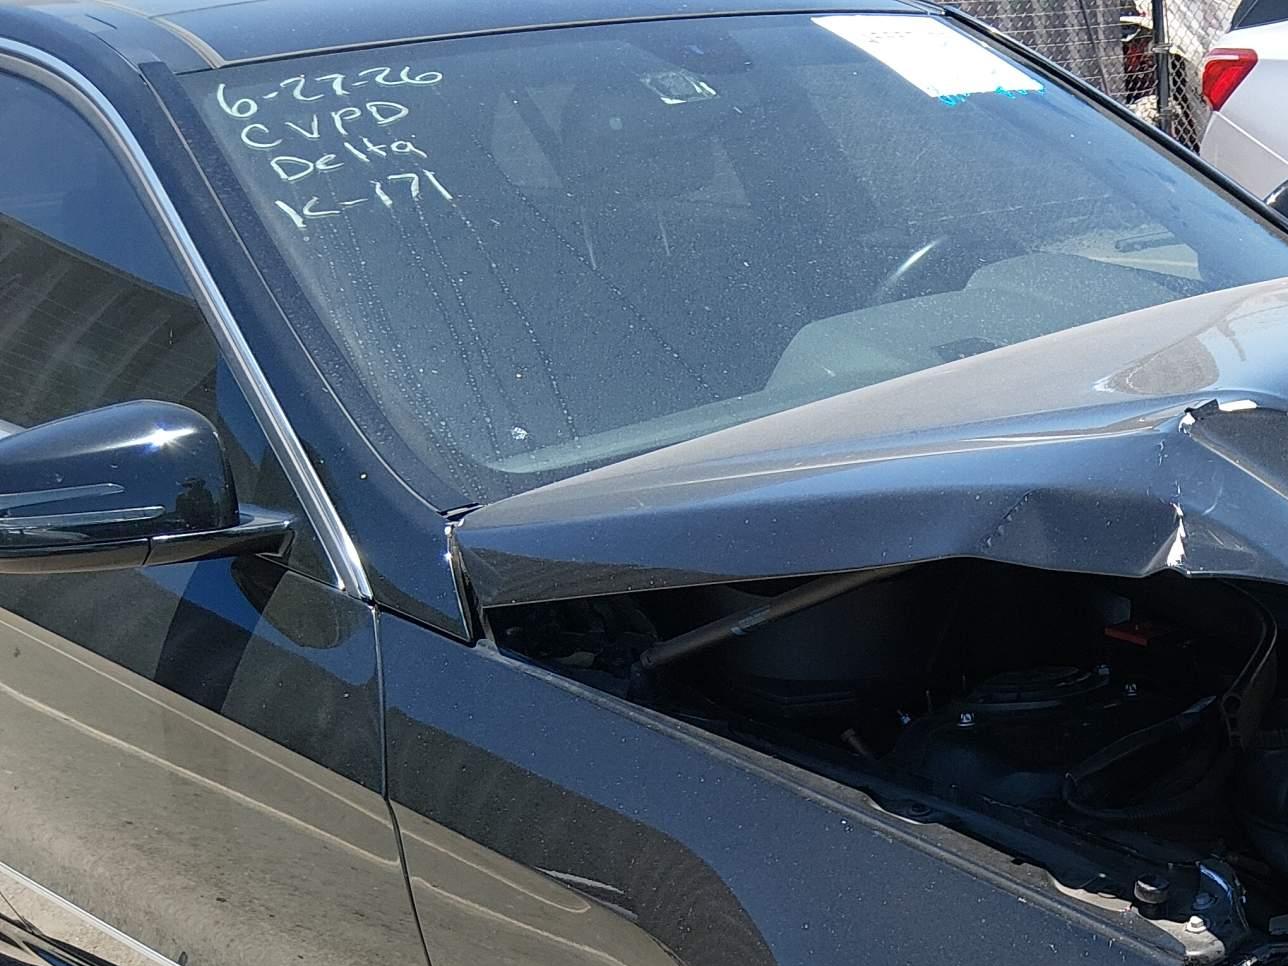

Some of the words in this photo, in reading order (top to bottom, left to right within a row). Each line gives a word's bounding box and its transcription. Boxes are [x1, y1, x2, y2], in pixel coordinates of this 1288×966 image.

[216, 66, 443, 118] 6-27-26
[270, 135, 427, 181] Delta
[275, 169, 453, 228] K-171
